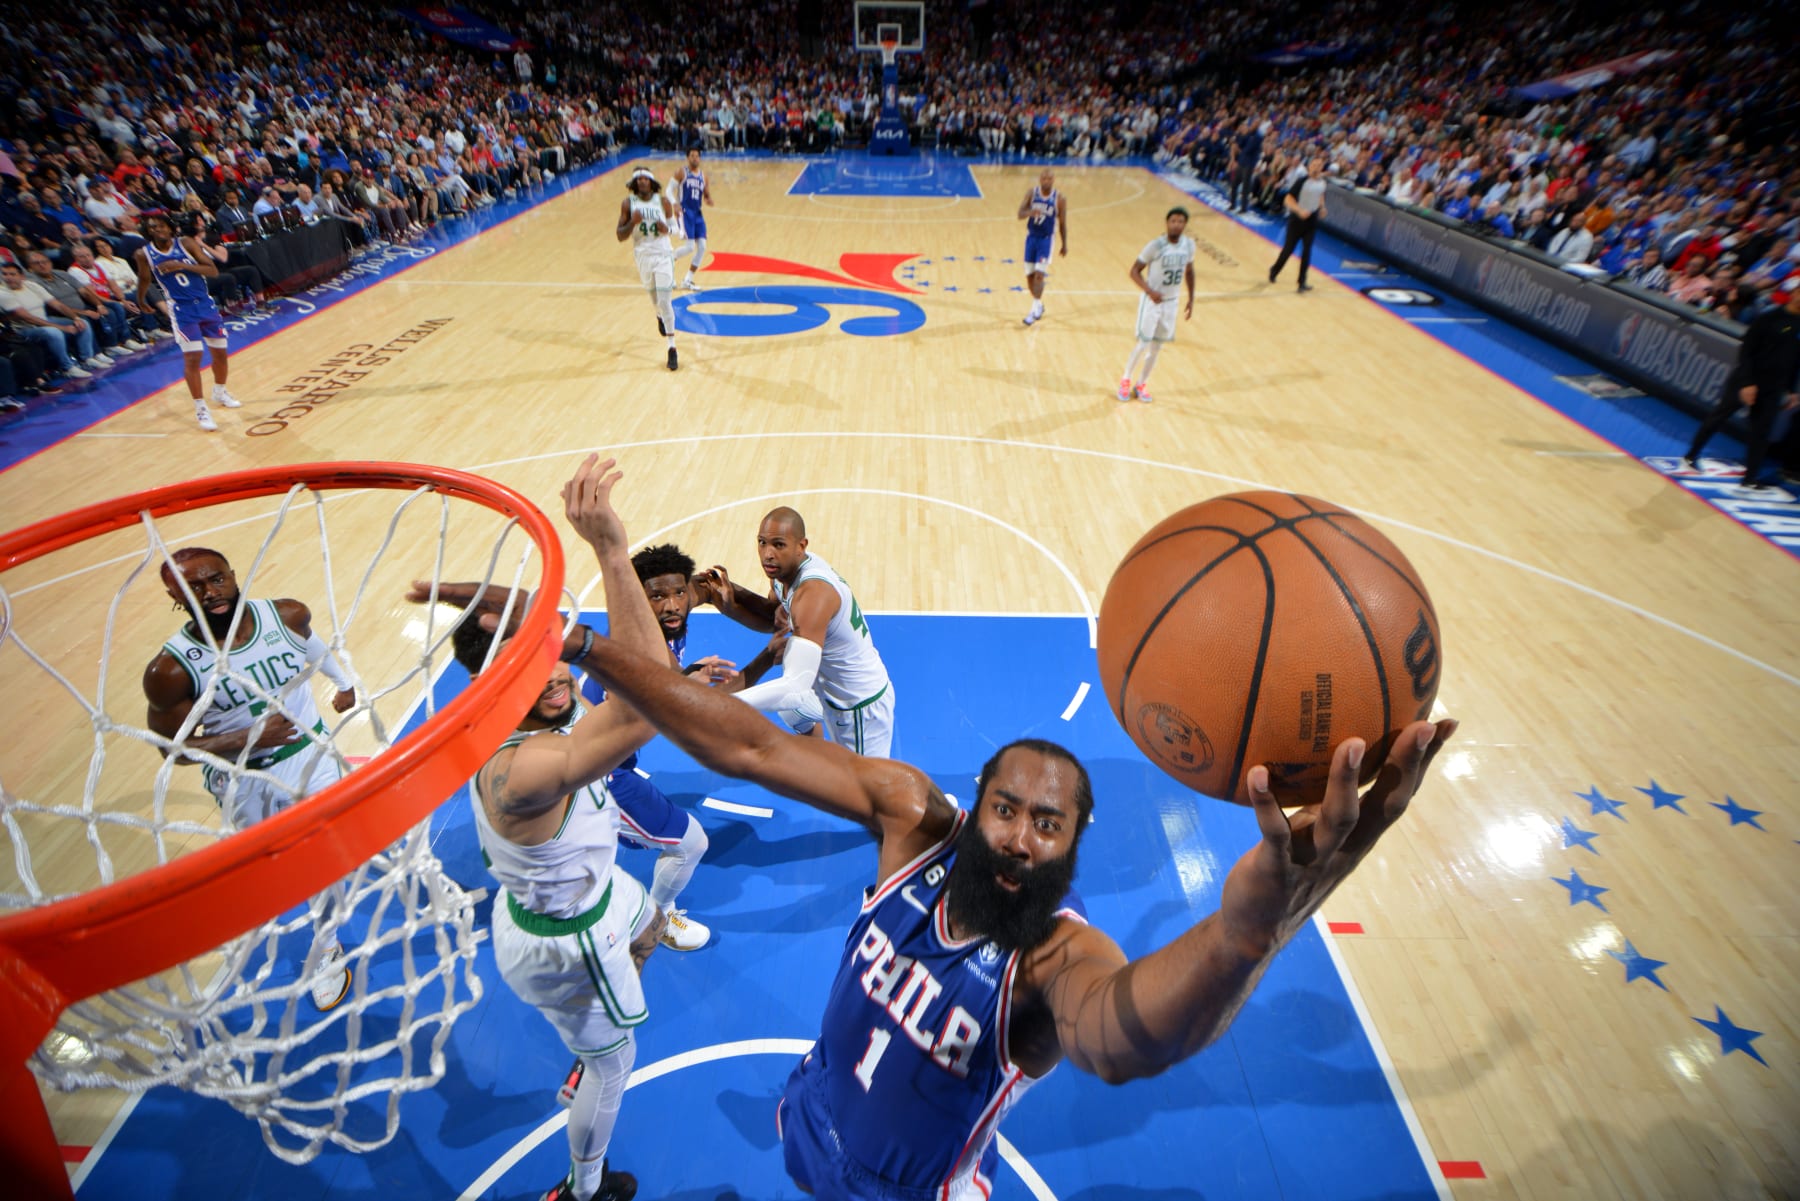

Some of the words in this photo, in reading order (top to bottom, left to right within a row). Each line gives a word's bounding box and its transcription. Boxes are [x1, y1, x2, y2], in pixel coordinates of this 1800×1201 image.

[876, 129, 904, 139] KIA
[691, 188, 700, 200] 12
[639, 221, 660, 237] 44
[174, 272, 190, 287] 0
[1161, 268, 1183, 286] 36
[1482, 257, 1592, 338] NBAStore.com
[356, 316, 455, 367] WELLS
[275, 343, 374, 393] CENTER
[245, 369, 373, 437] FARGO
[189, 649, 200, 660] 6
[925, 864, 945, 886] 6
[851, 920, 982, 1078] PHILA
[854, 1027, 891, 1093] 1
